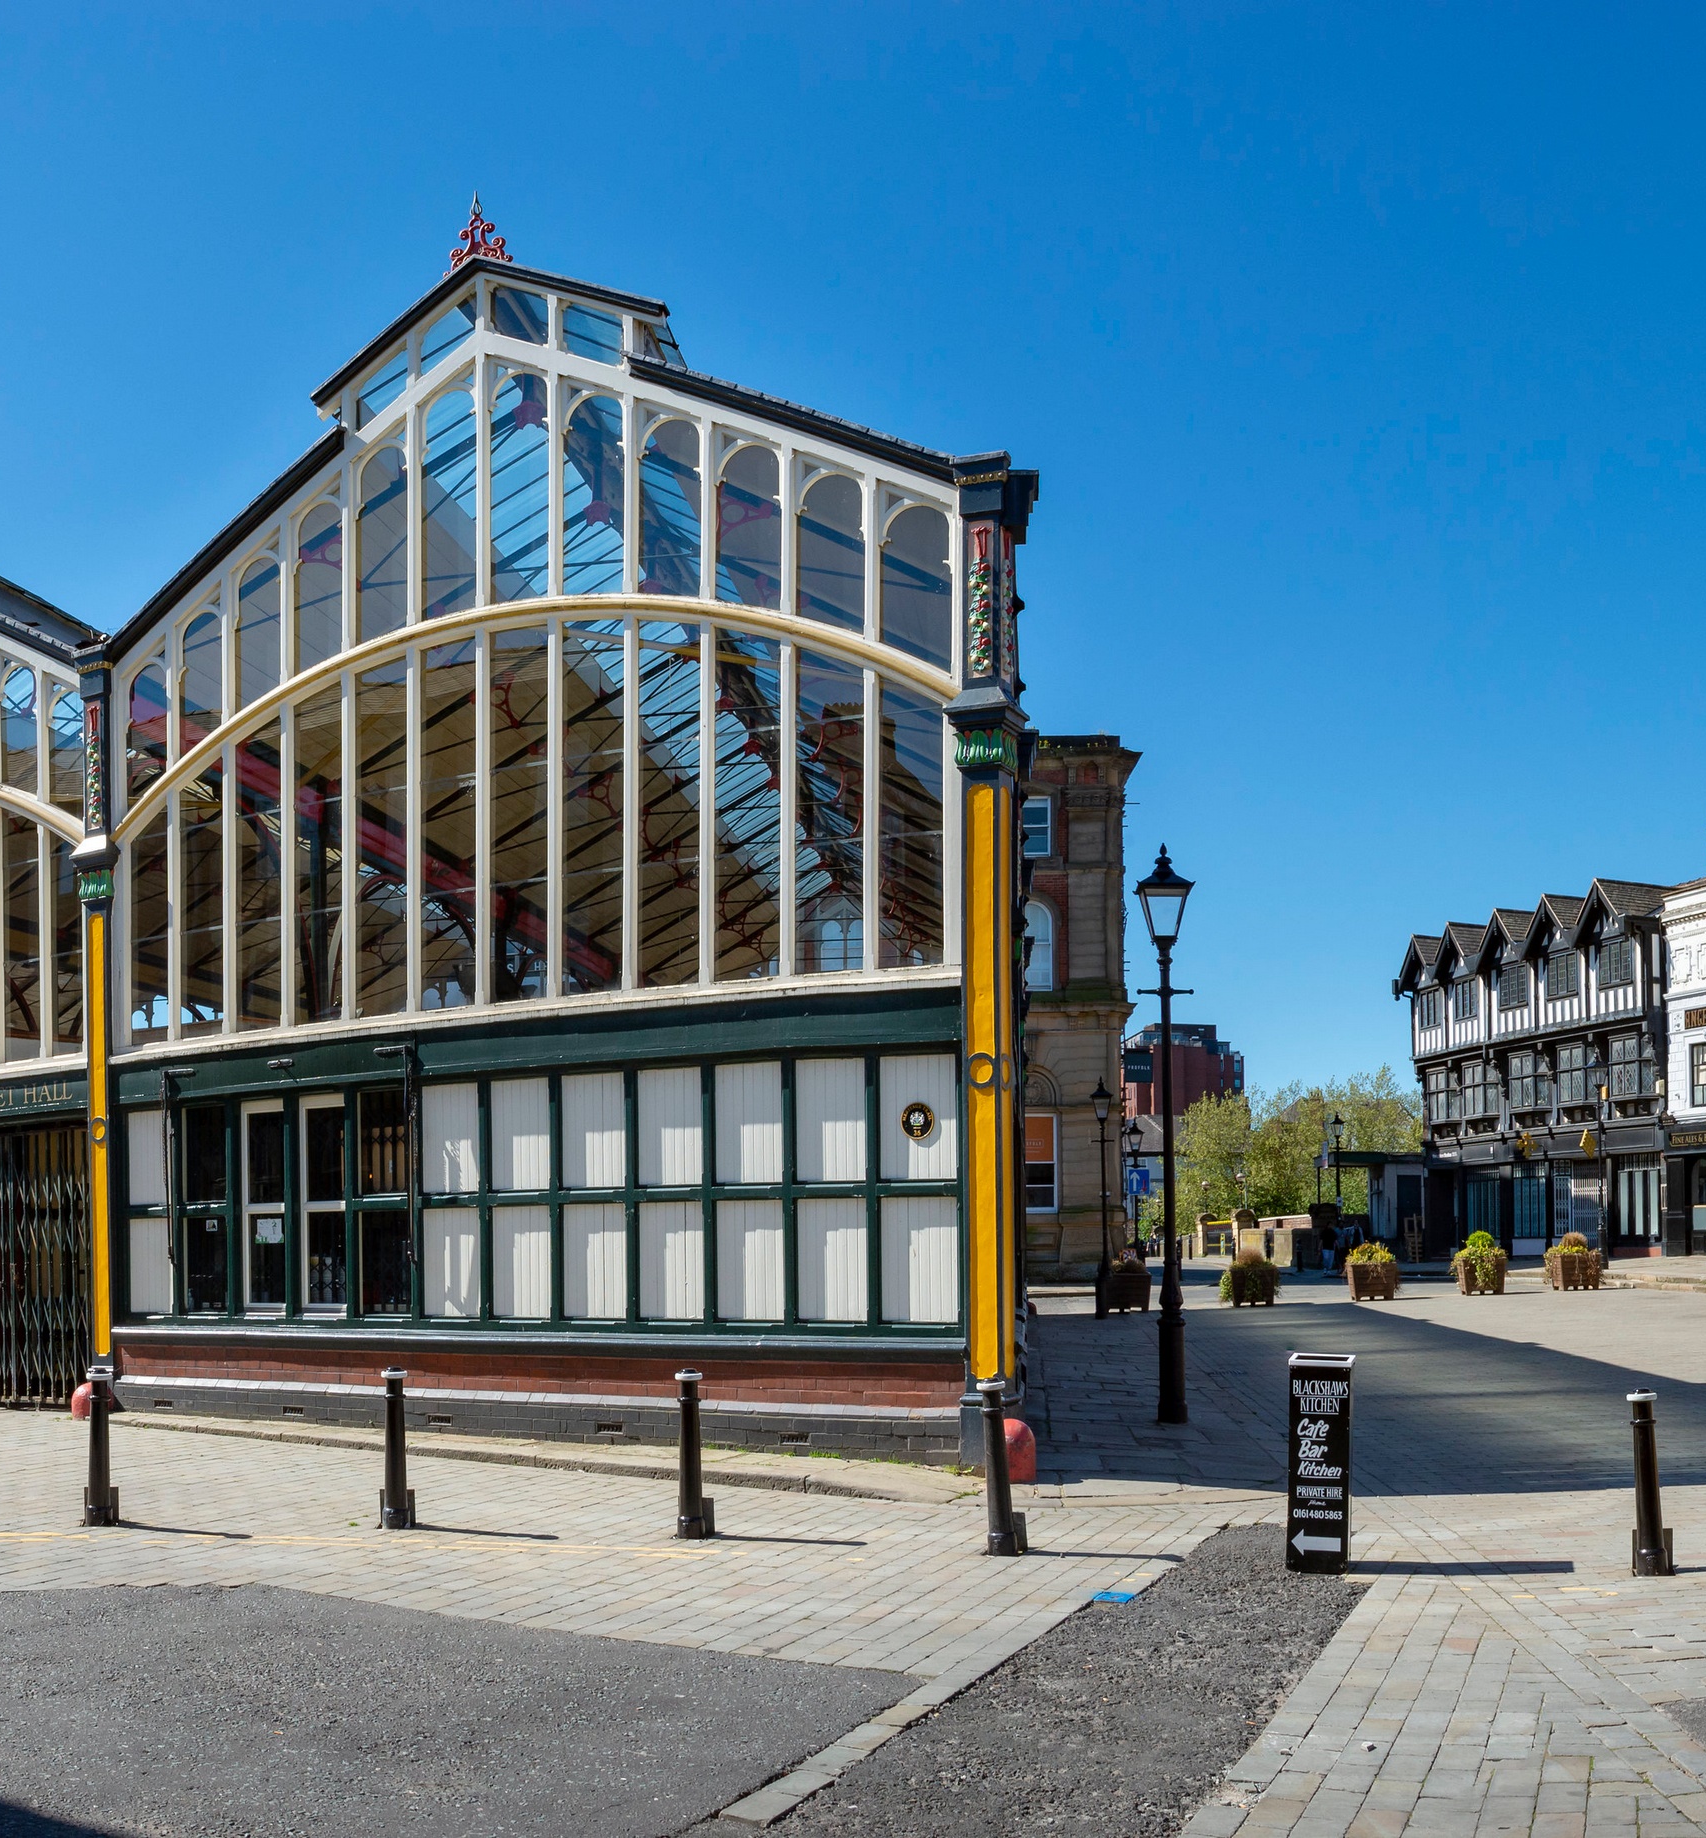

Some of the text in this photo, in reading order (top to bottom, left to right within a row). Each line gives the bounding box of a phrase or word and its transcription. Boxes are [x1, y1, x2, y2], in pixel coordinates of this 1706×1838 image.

[23, 1079, 73, 1104] HALL
[1293, 1379, 1349, 1396] BLACKSHAWS
[1300, 1397, 1340, 1412] KITCHEN
[1297, 1418, 1330, 1439] Cafe
[1298, 1440, 1328, 1458] Bar
[1297, 1460, 1342, 1477] Kitchen
[1297, 1487, 1343, 1498] PRIVATE HIRE
